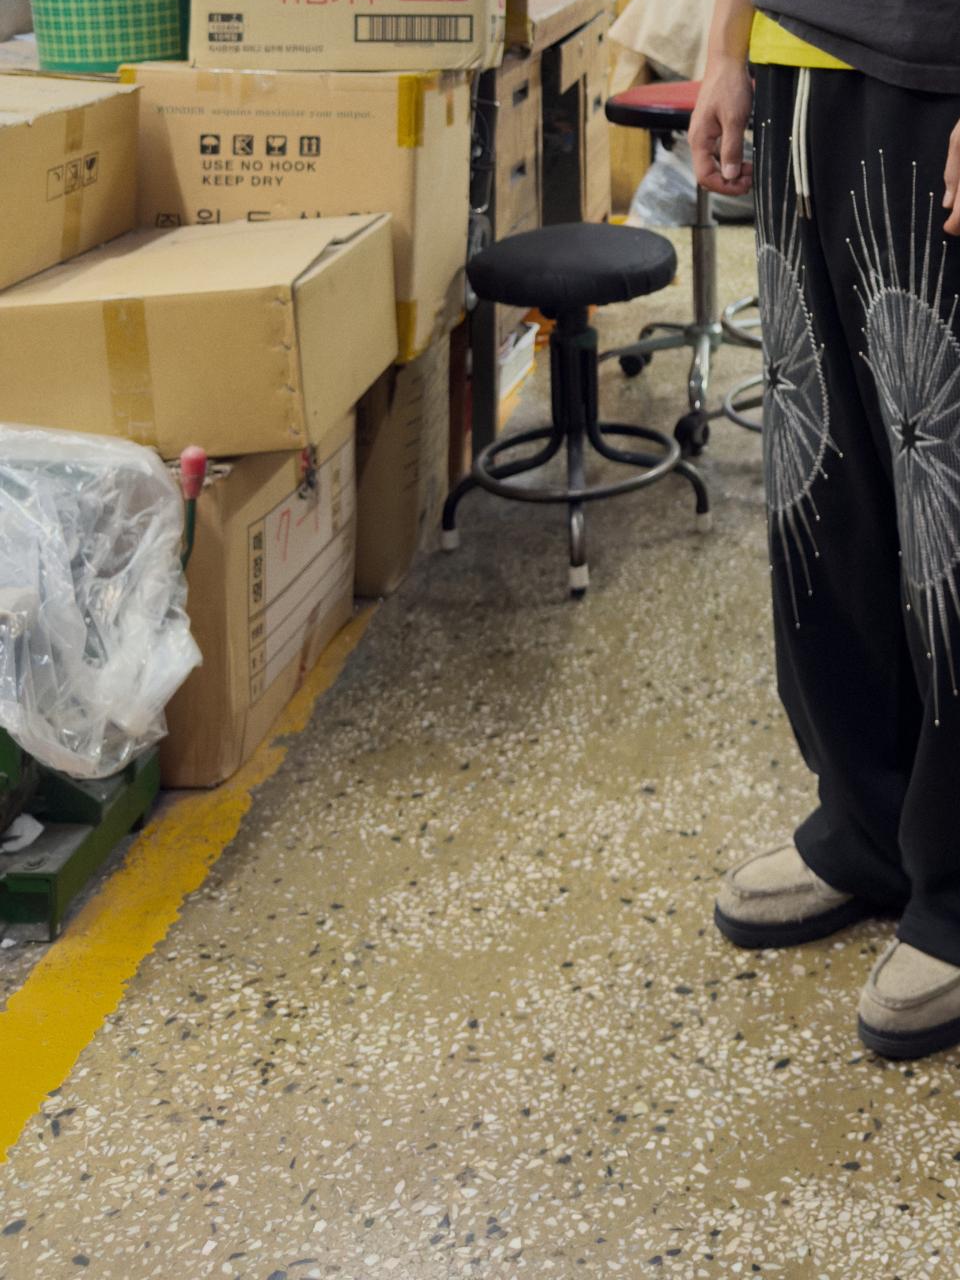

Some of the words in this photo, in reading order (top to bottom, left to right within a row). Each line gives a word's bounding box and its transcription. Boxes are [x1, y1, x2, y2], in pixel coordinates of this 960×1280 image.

[202, 160, 234, 171] USE
[241, 160, 264, 171] NO
[270, 160, 317, 173] HOOK
[202, 175, 245, 187] KEEP
[252, 175, 285, 187] DRY
